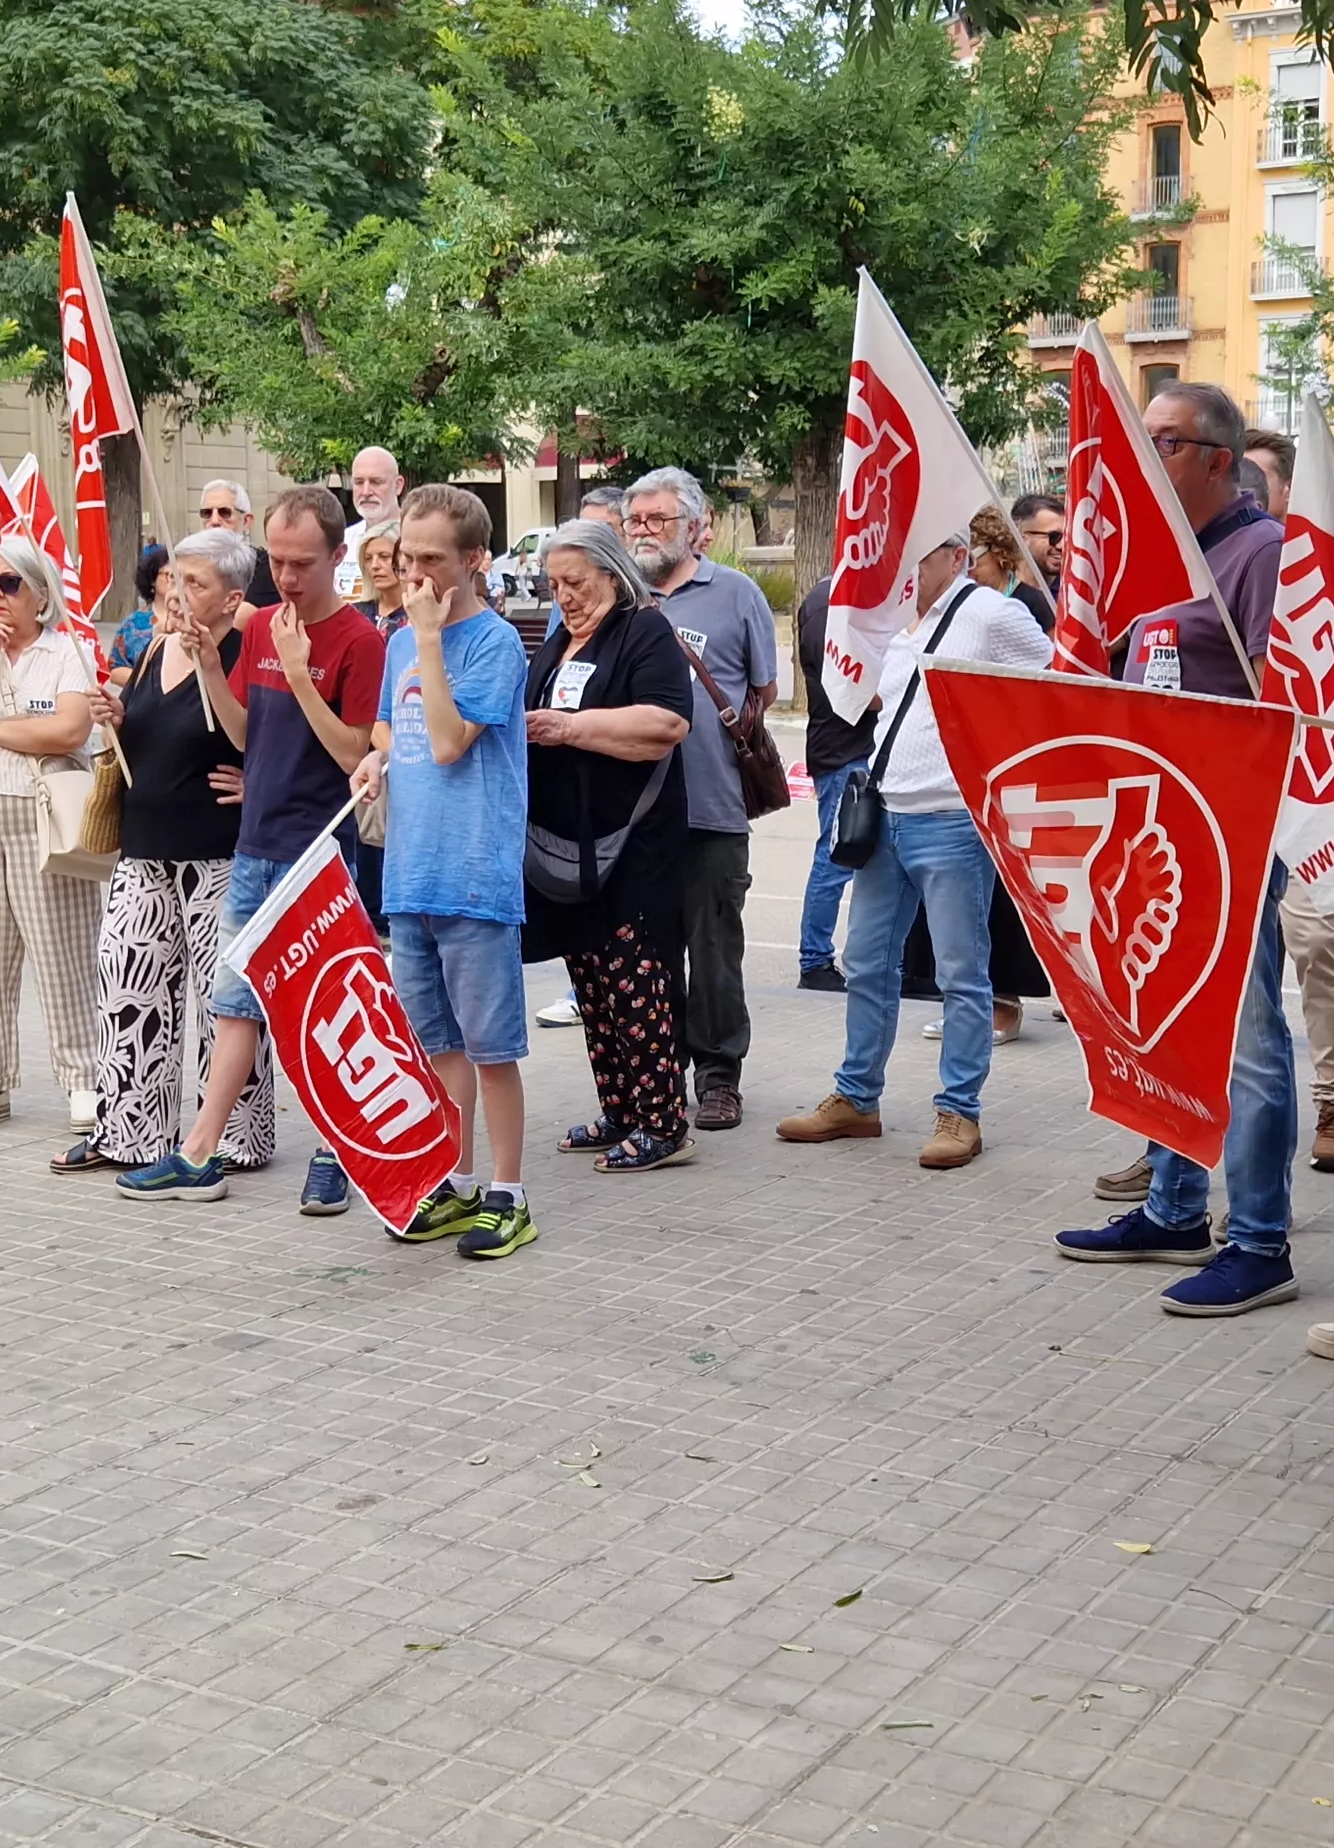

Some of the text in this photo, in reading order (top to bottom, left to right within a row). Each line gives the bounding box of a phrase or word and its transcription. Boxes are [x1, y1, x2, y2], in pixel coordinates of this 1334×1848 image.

[1143, 629, 1160, 648] UGT
[1153, 648, 1176, 660] STOP
[567, 664, 592, 672] STOP
[29, 699, 54, 709] STOP
[311, 998, 431, 1145] UGT
